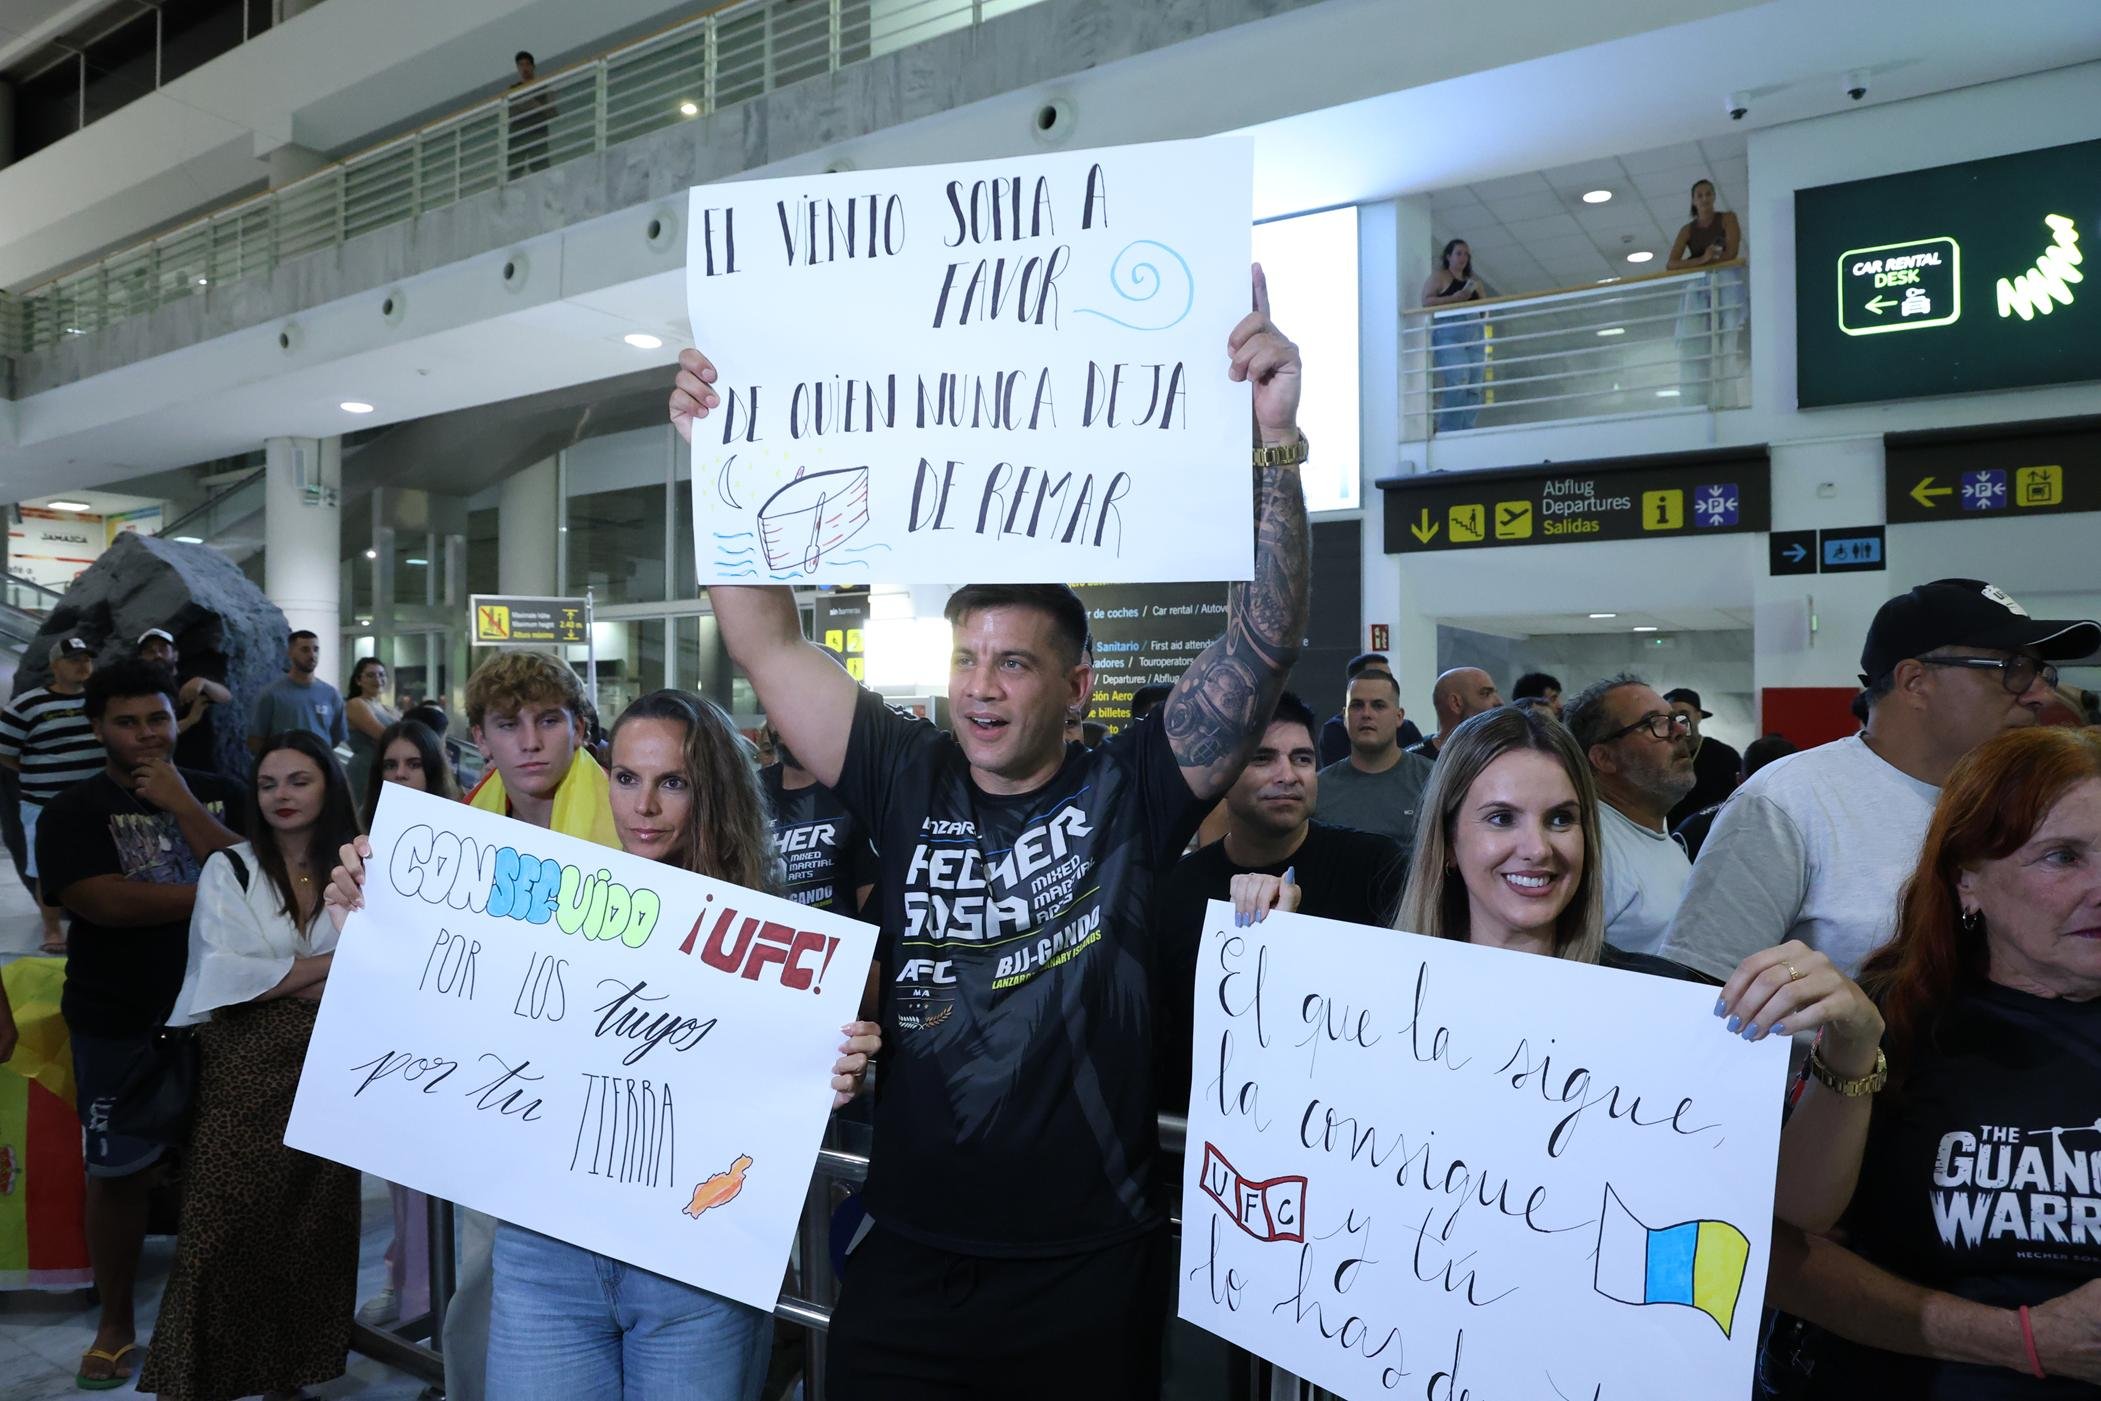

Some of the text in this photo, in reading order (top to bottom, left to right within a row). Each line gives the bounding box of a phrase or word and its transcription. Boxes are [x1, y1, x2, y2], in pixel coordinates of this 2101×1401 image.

[704, 207, 741, 277] EL
[943, 175, 1056, 249] SOPLA
[1081, 163, 1108, 230] A
[1852, 252, 1942, 276] CAR RENTAL
[932, 244, 1071, 331] FAVOR
[1874, 268, 1920, 289] DESK
[722, 385, 763, 445] DE
[915, 367, 1057, 432] NUNCA
[1081, 360, 1187, 430] DEJA
[1543, 479, 1594, 498] Abflug
[907, 457, 1131, 559] DE REMAR
[1542, 495, 1631, 516] Departures
[1543, 518, 1600, 536] Salidas
[1093, 608, 1106, 619] de
[1107, 608, 1139, 618] coches
[1152, 605, 1168, 616] Car
[1169, 604, 1193, 615] rental
[1097, 641, 1139, 651] Sanitario
[1151, 641, 1169, 650] First
[1170, 639, 1183, 650] aid
[1102, 674, 1146, 685] Departures
[1111, 691, 1134, 701] Aero
[1098, 707, 1132, 718] billetes
[773, 823, 836, 853] HER
[789, 859, 835, 871] MARTIAL
[790, 851, 822, 862] MIXED
[788, 870, 814, 880] ARTS
[1031, 854, 1081, 895] MIXED
[904, 890, 1032, 940] SOSA
[994, 905, 1101, 978] BJJ-GANDO
[896, 959, 957, 984] AFC
[419, 928, 718, 1067] POR LOS tuyos
[1215, 930, 1270, 1048] El
[1295, 993, 1382, 1078] que
[1398, 961, 1472, 1071] la
[1206, 1029, 1271, 1133] la
[350, 1049, 675, 1188] por tu TIERRA
[1980, 1125, 2020, 1143] THE
[1930, 1190, 2101, 1250] WARR
[1312, 1208, 1380, 1294] y
[1189, 1213, 1250, 1312] lo
[1272, 1243, 1412, 1389] has
